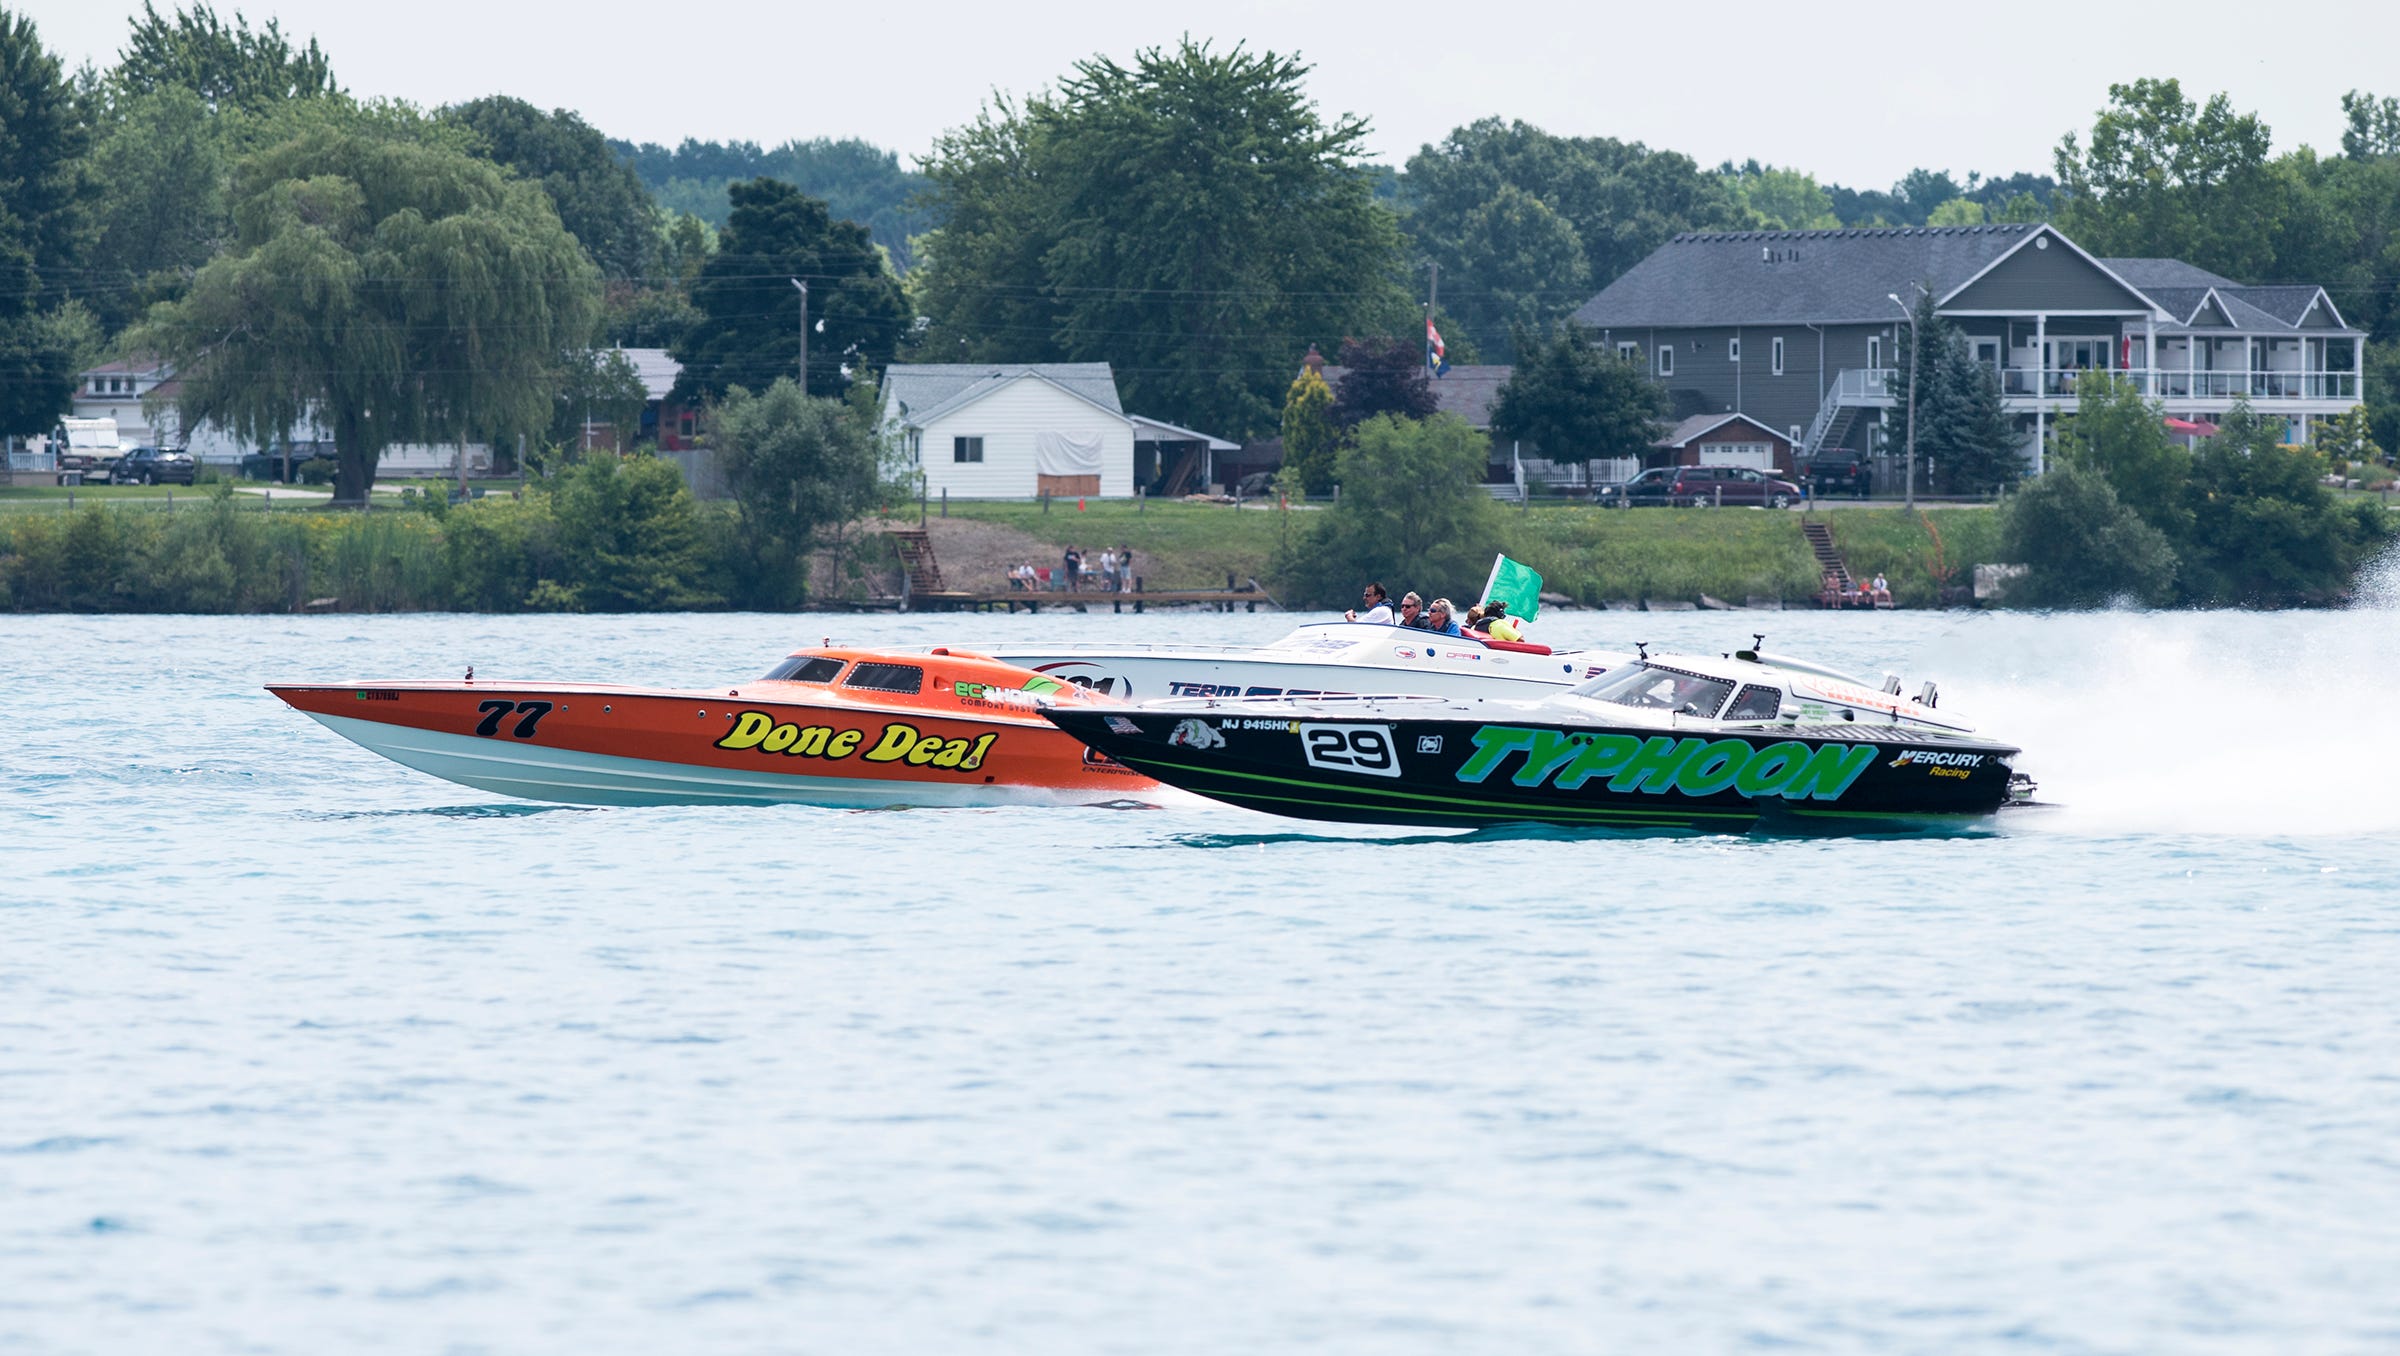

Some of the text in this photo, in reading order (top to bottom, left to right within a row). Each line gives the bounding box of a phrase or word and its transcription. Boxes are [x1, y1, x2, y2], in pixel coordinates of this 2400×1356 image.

[1169, 682, 1241, 697] TEAM
[960, 697, 1005, 710] COMFORT
[475, 699, 554, 739] 77
[1222, 719, 1291, 731] NJ 9415HK
[713, 710, 999, 773] Done Deal
[1308, 729, 1392, 770] 29
[1456, 725, 1879, 800] TYPHOON
[1929, 765, 1971, 780] Racing
